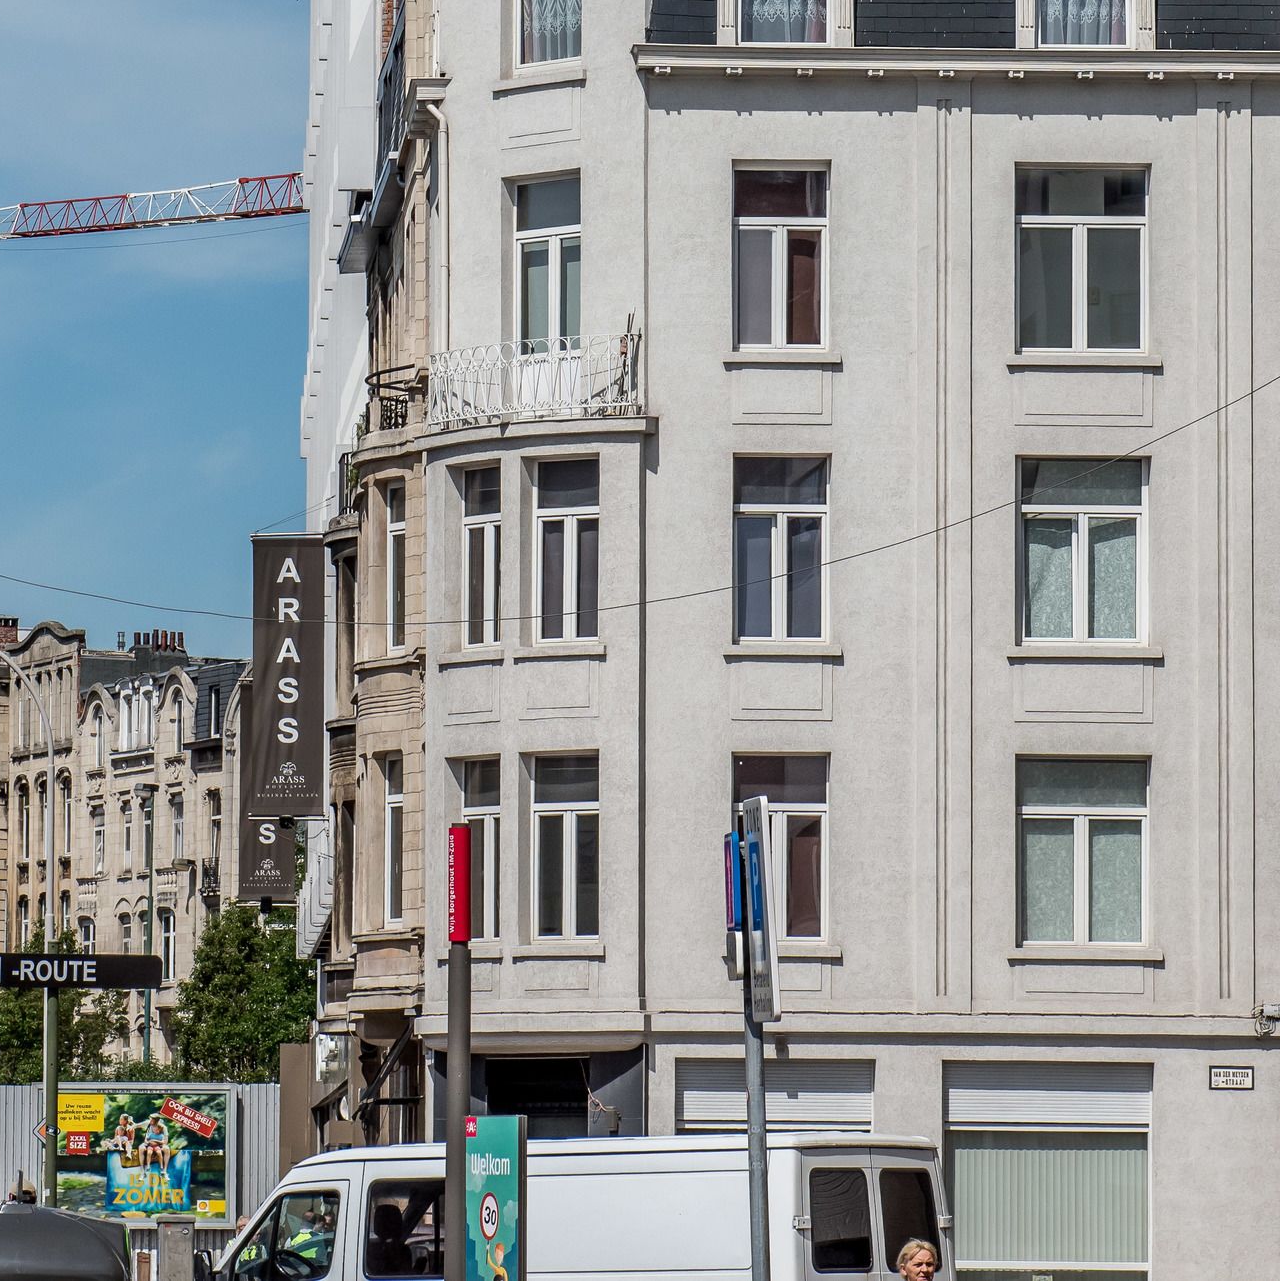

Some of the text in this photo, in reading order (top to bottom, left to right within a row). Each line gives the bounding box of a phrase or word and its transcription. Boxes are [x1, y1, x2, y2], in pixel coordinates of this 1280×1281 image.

[276, 556, 301, 745] ARASS
[271, 775, 306, 784] ARASS
[168, 1100, 212, 1127] OOK BIJ SHELL
[172, 1112, 201, 1130] EXPRESS!
[471, 1152, 511, 1176] Welkom
[129, 1173, 144, 1188] IS
[112, 1188, 185, 1205] ZOMER
[483, 1205, 497, 1226] 30
